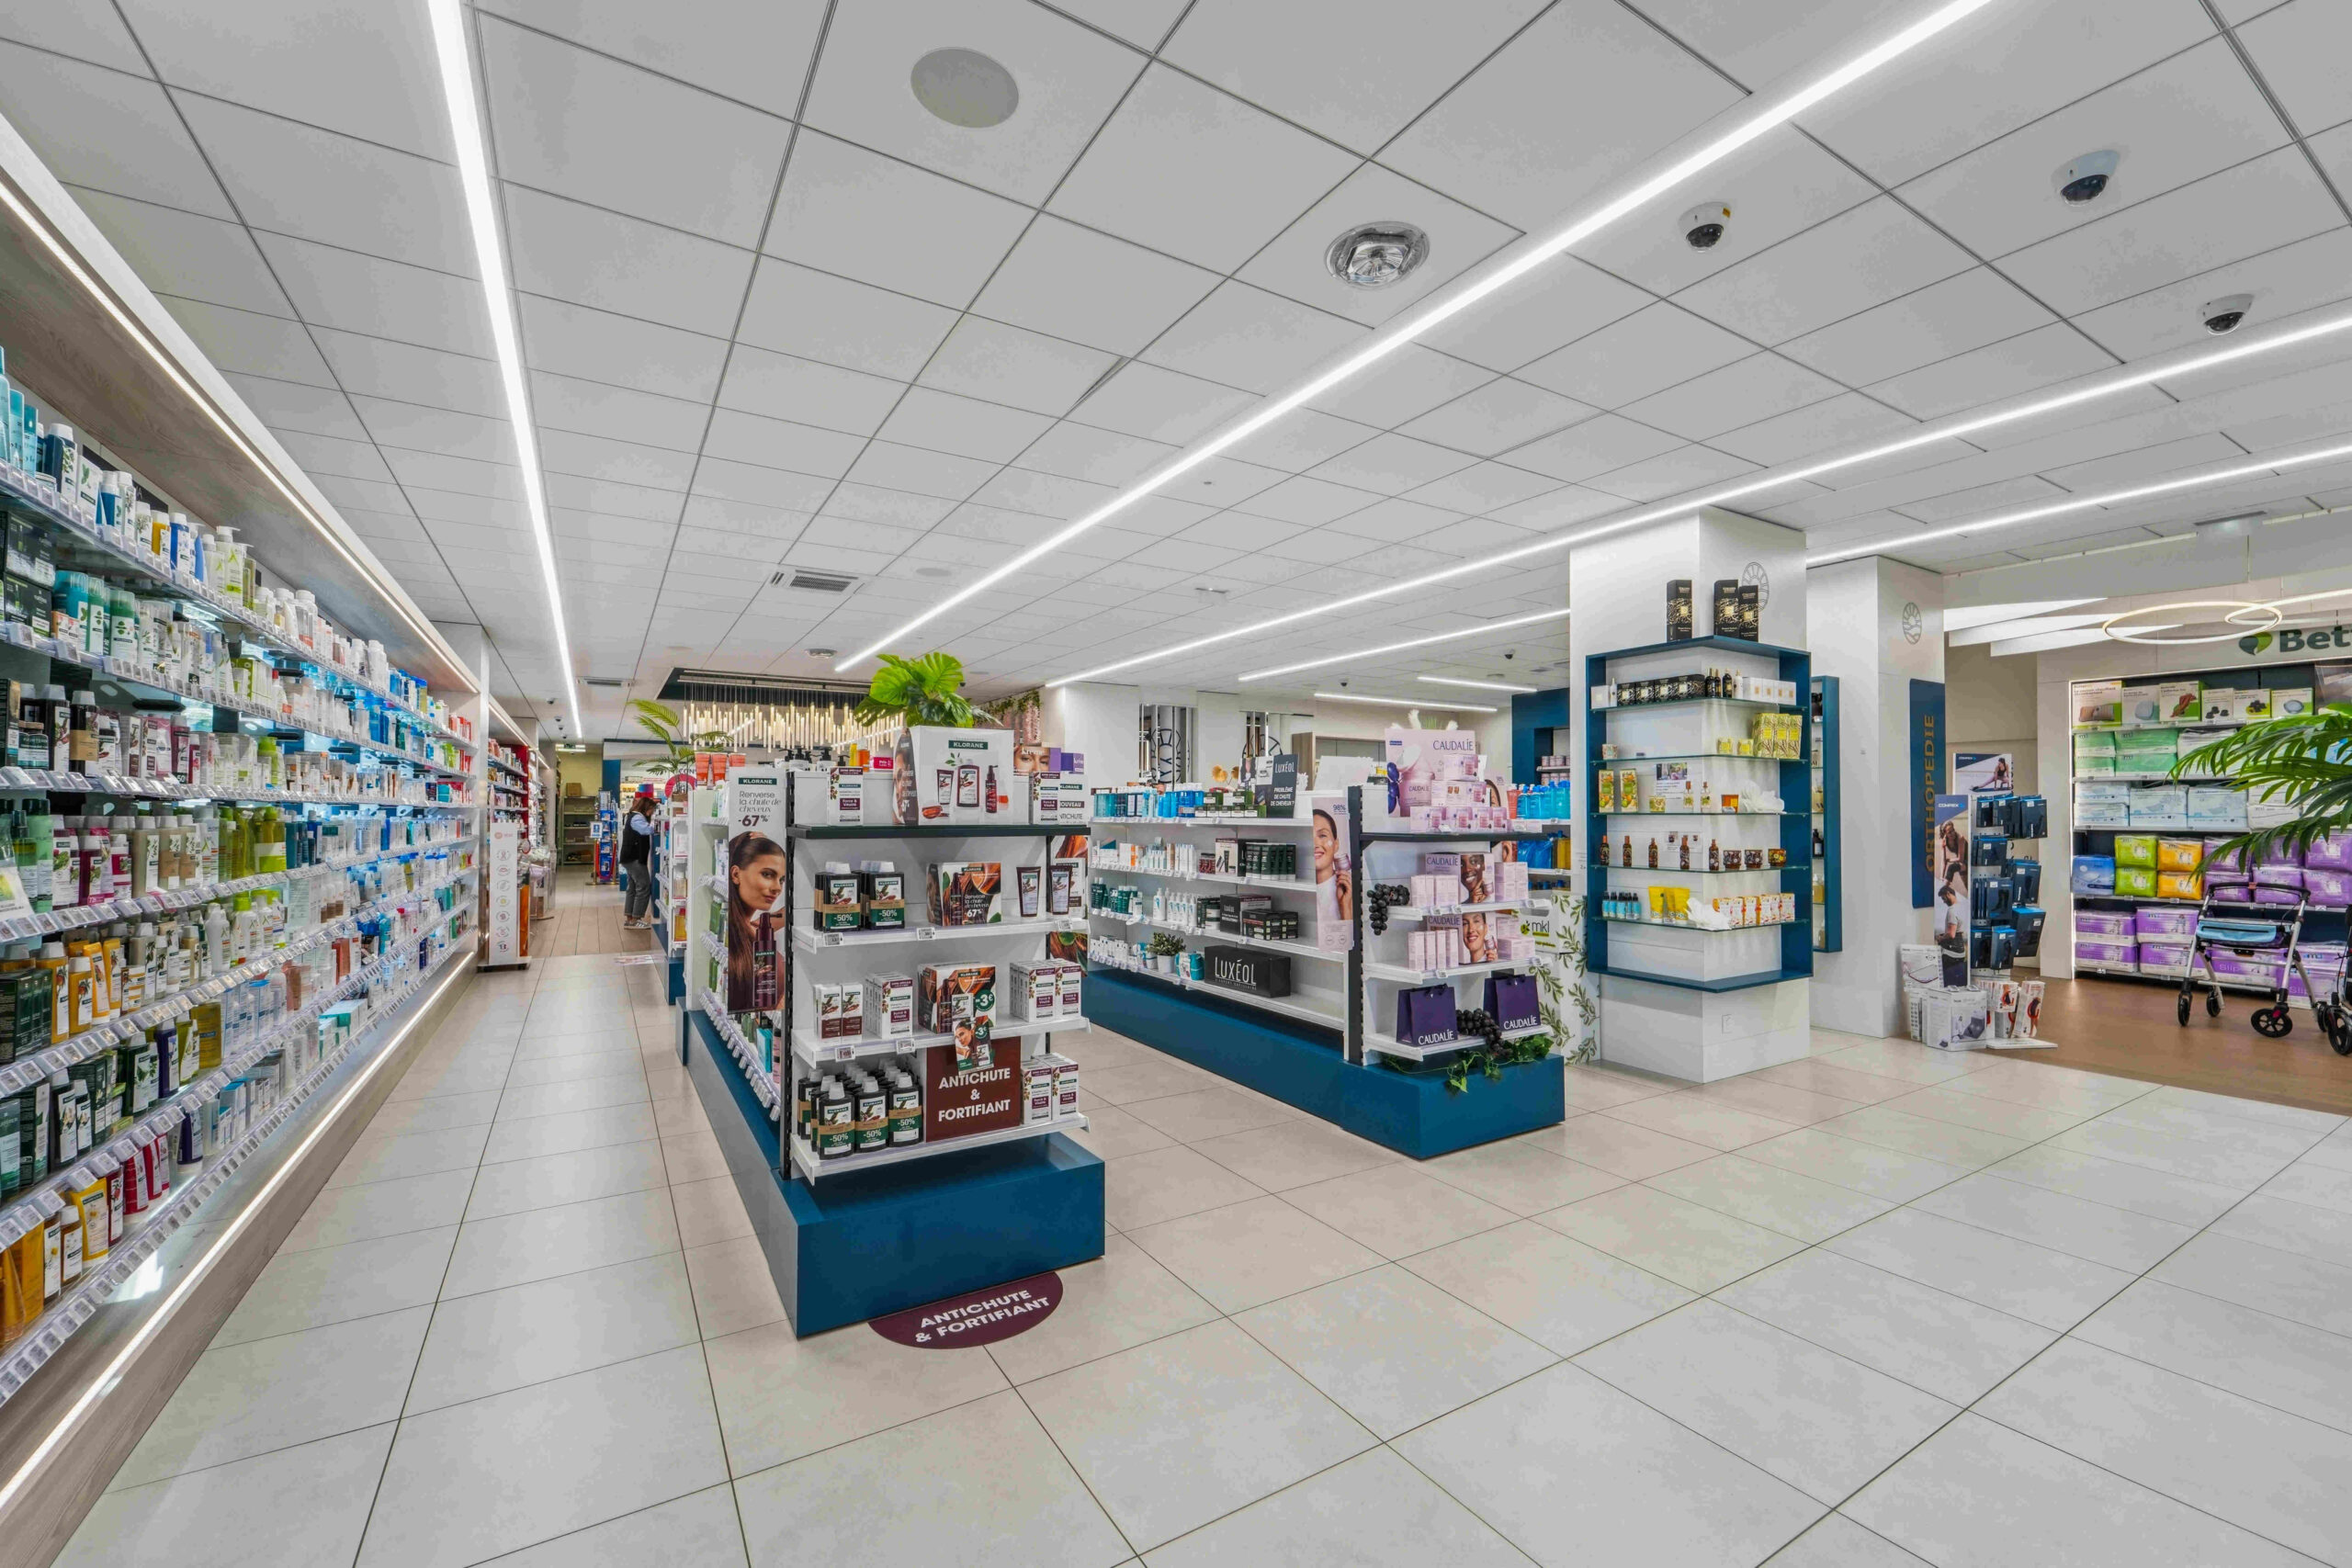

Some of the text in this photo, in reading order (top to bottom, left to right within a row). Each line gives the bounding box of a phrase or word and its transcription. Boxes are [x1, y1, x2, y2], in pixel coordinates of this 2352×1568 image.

[1275, 761, 1295, 773] LUXÉOL
[1924, 715, 1934, 873] ORTHOPEDIE
[1532, 920, 1549, 932] mkl
[1215, 956, 1257, 985] LUXÉOL
[2219, 964, 2239, 973] Slip
[976, 994, 993, 1007] -3€
[938, 1067, 1010, 1089] ANTICHUTE
[970, 1089, 980, 1100] &
[938, 1100, 1011, 1122] FORTIFIANT
[830, 1134, 849, 1142] -50%
[921, 1290, 1032, 1328] ANTICHUTE
[915, 1297, 1050, 1343] & FORTIFIANT
